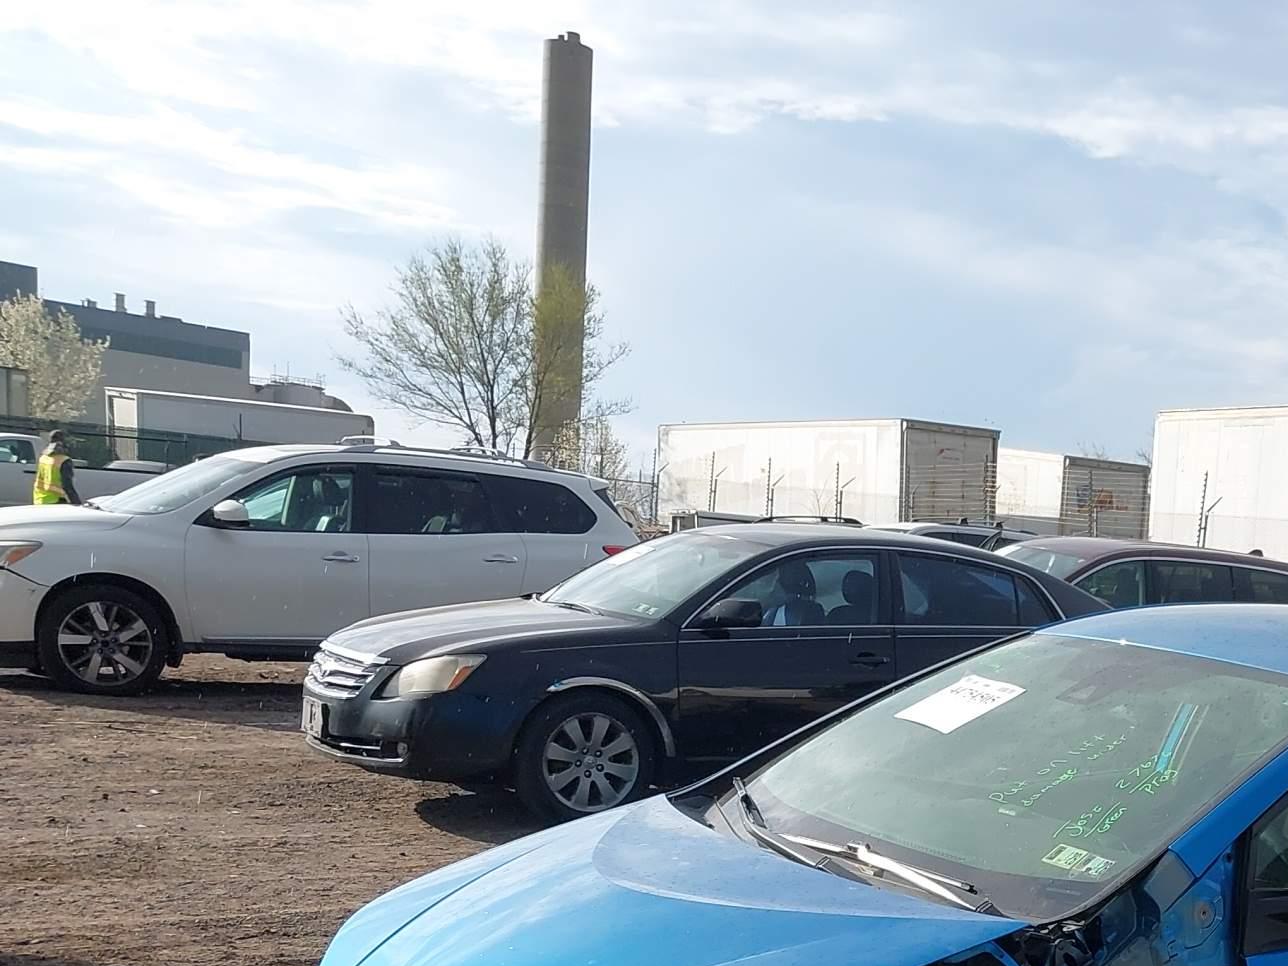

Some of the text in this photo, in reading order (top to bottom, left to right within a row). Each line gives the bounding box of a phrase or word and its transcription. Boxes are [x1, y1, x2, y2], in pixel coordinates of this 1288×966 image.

[988, 780, 1027, 804] Put
[1036, 759, 1068, 775] on
[1021, 767, 1078, 806] damage
